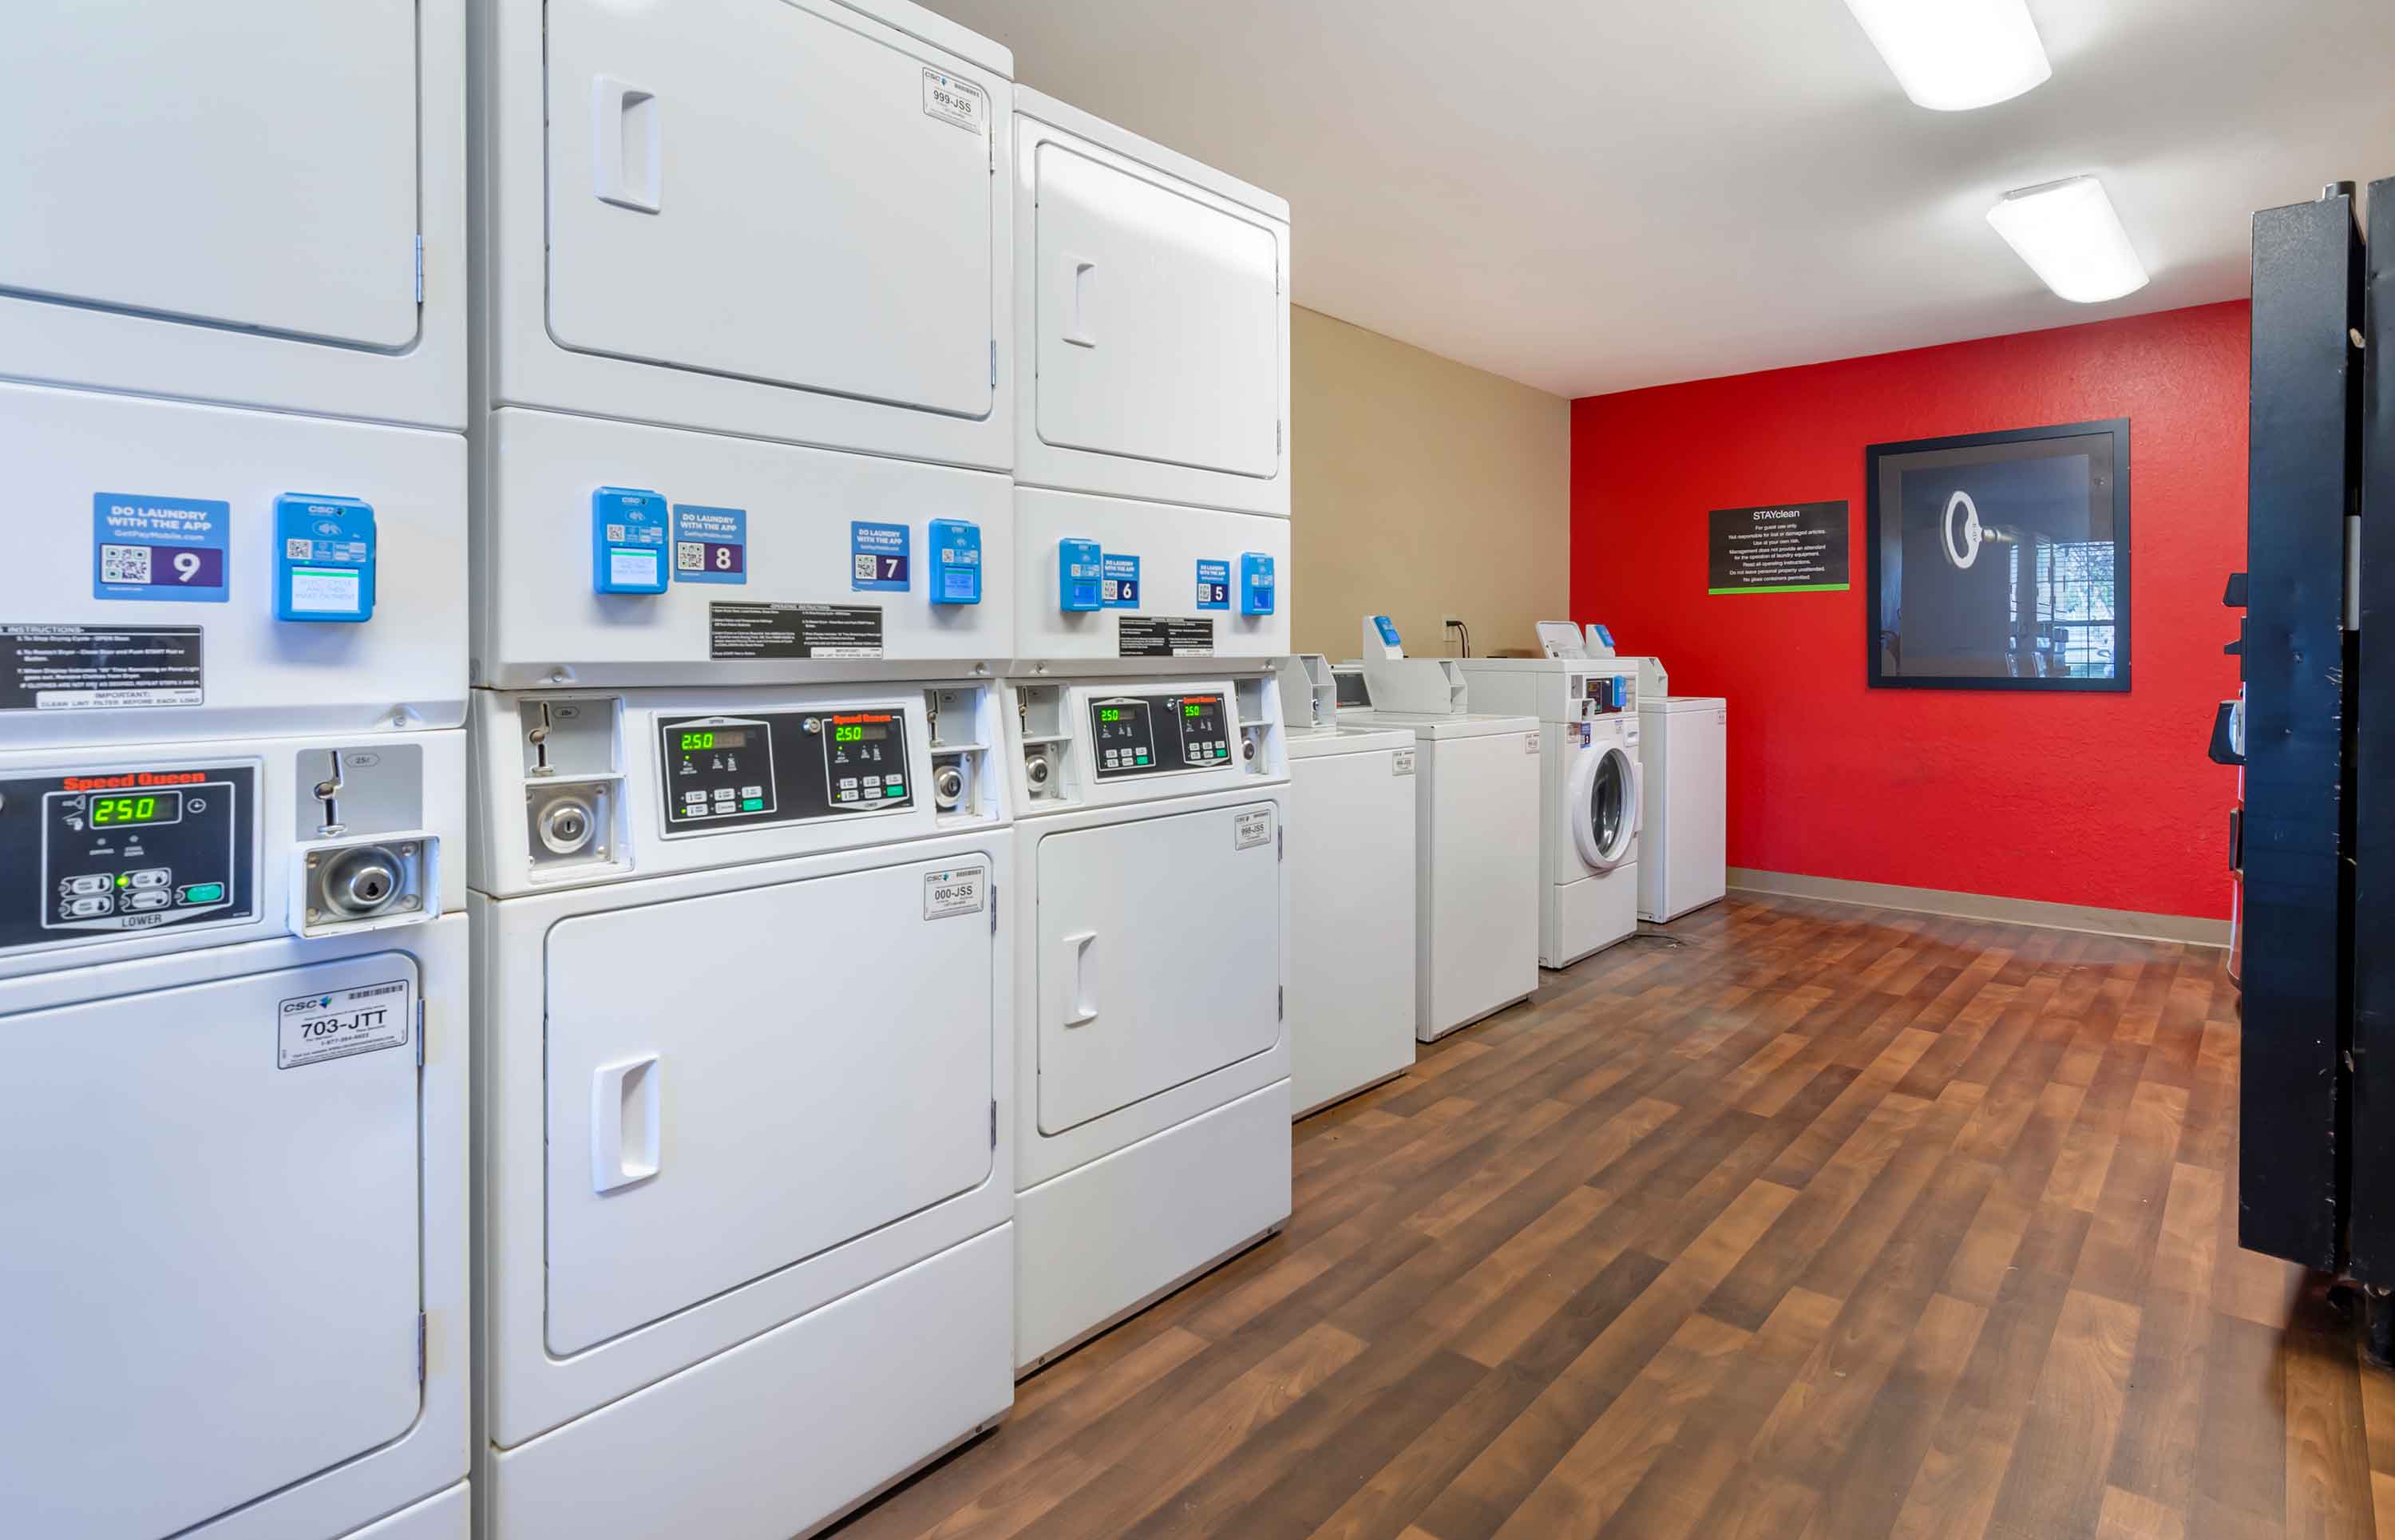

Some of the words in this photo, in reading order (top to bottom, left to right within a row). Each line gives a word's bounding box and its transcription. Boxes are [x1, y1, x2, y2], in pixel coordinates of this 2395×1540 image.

[933, 89, 971, 113] 999-JSS
[111, 505, 134, 516] DO
[138, 507, 207, 521] LAUNDRY
[697, 514, 734, 525] LAUNDRY
[1753, 510, 1800, 521] STAYclean
[107, 517, 147, 528] WITH
[152, 519, 180, 530] THE
[183, 521, 212, 531] APP
[716, 548, 731, 569] 8
[173, 552, 200, 583] 9
[885, 559, 898, 578] 7
[1123, 583, 1132, 599] 6
[1216, 586, 1223, 601] 5
[63, 774, 135, 791] Speed
[137, 772, 206, 786] Queen
[934, 885, 973, 901] 000-JSS
[121, 914, 162, 928] LOWER
[283, 1000, 318, 1013] CSC
[300, 1009, 388, 1039] 703-JTT
